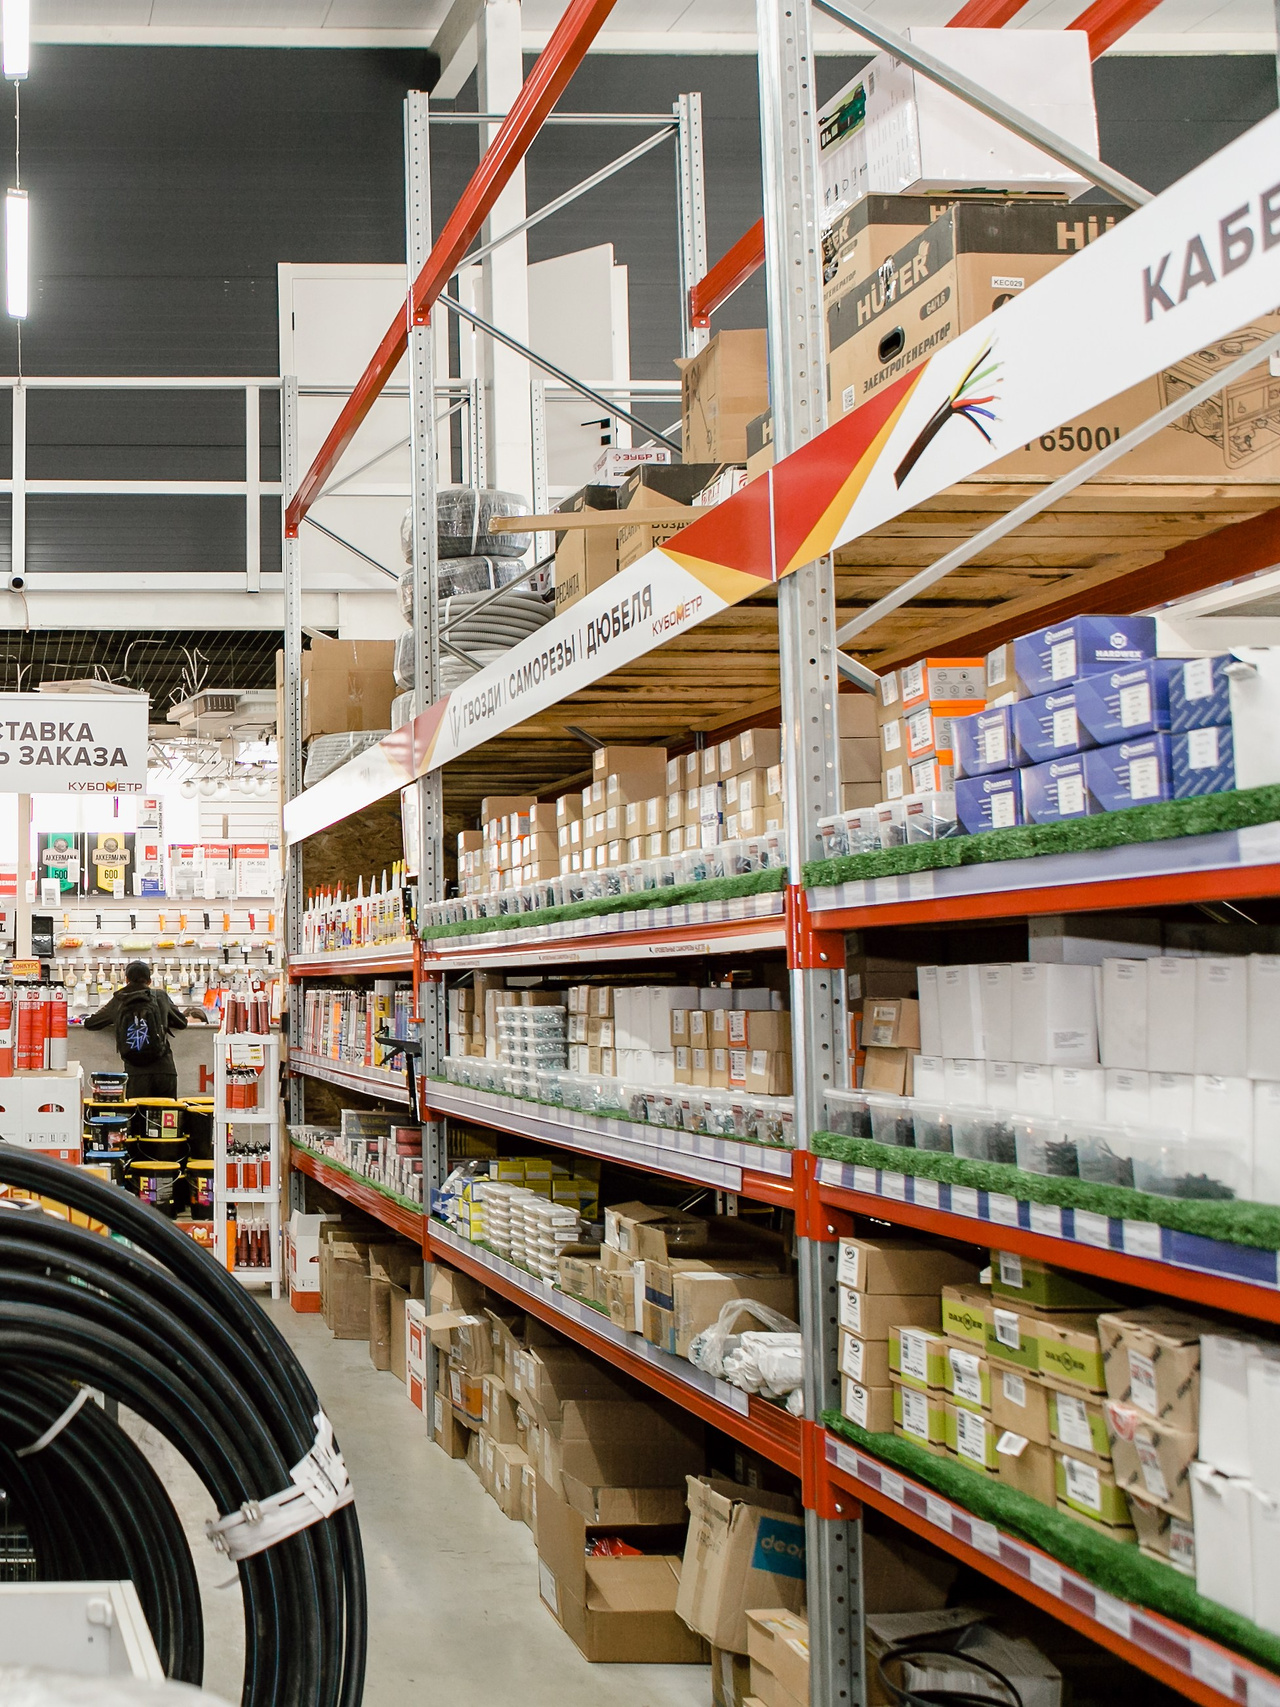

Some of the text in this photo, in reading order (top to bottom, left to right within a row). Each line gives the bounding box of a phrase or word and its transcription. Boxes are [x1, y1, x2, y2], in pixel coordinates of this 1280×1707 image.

[993, 279, 1023, 288] KEC029
[863, 321, 951, 394] ЭЛЕКТРОГЕНЕРАТОР
[651, 595, 703, 637] КУБОМЕТР
[463, 584, 653, 728] ГВОЗДИ САМОРЕЗЫ ДЮБЕЛЯ
[1095, 650, 1141, 659] HARDWEX
[19, 746, 128, 767] ЗАКАЗА
[68, 780, 143, 792] КУБОМЕТР
[54, 869, 68, 879] 500
[104, 869, 118, 879] 600
